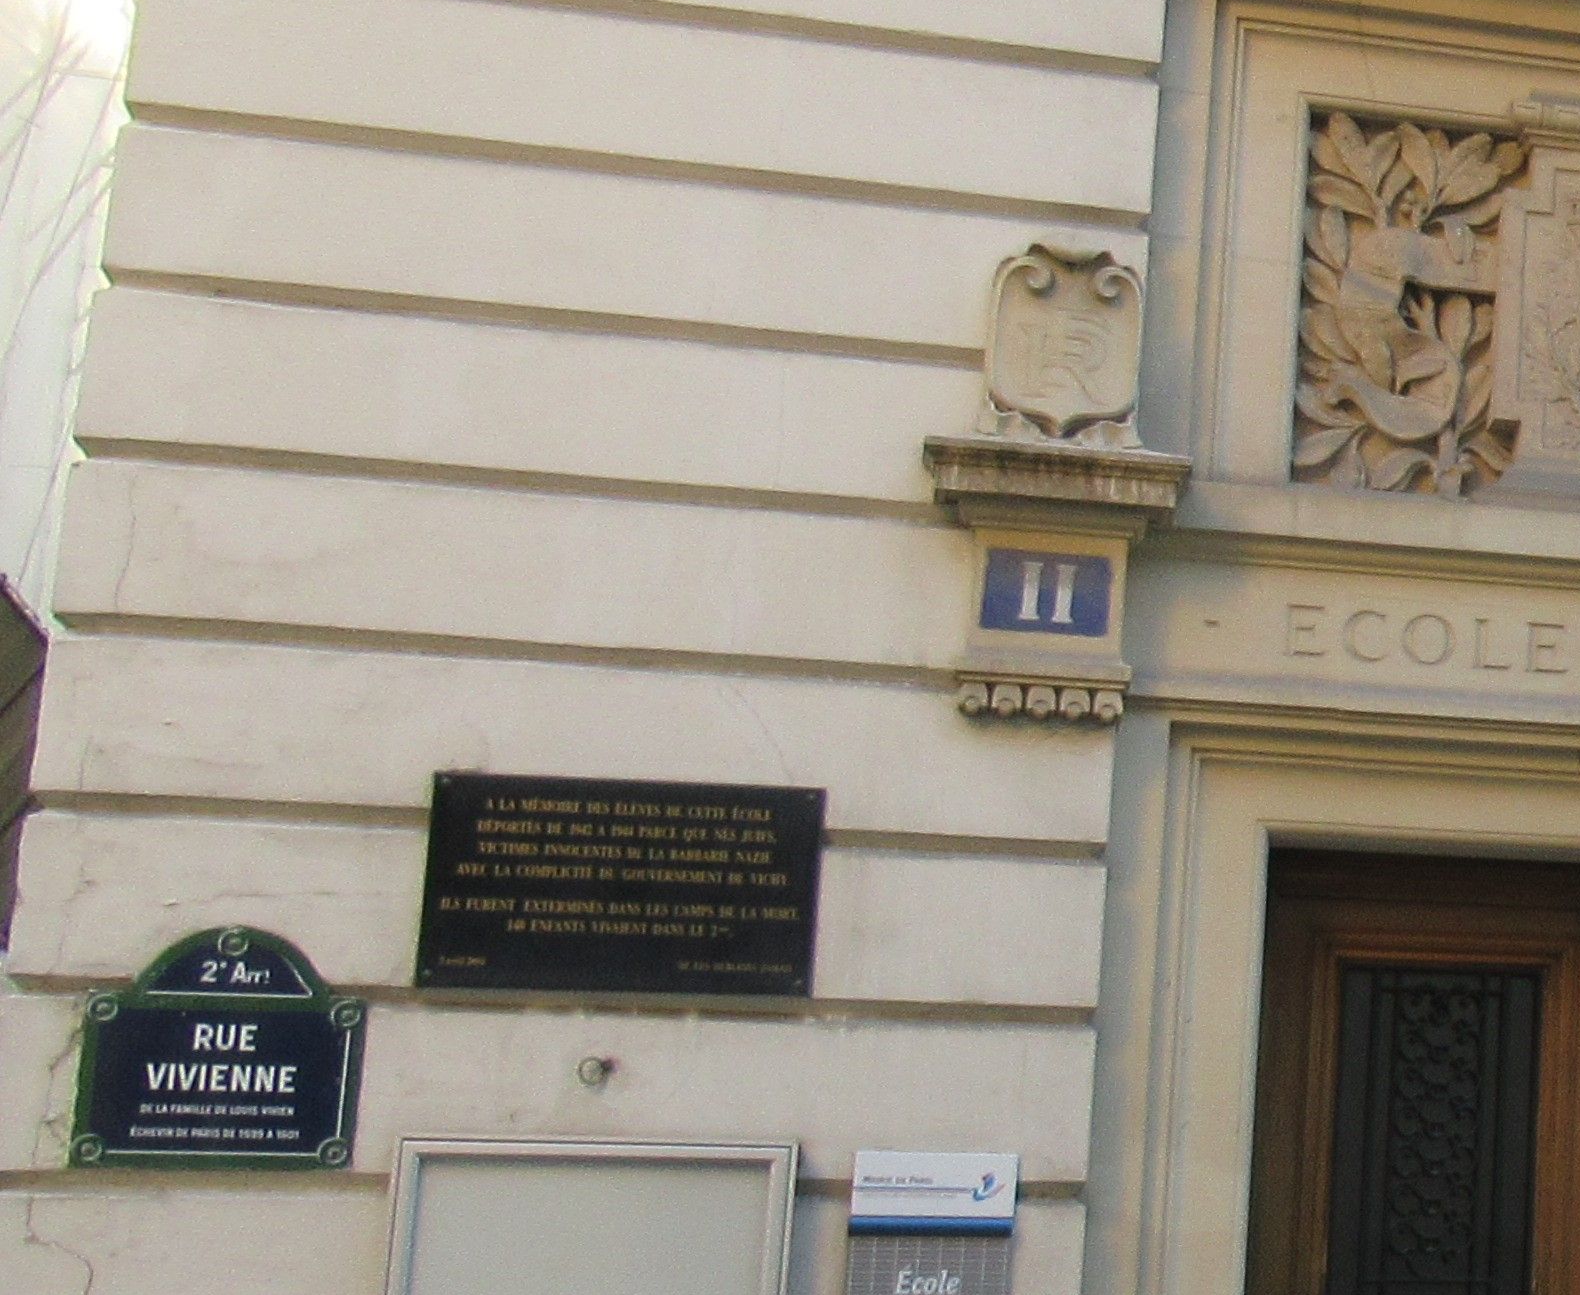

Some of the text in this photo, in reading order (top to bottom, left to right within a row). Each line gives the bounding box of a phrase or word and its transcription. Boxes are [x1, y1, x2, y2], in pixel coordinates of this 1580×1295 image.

[1284, 603, 1568, 673] ECOLE
[192, 1023, 258, 1052] RUE
[146, 1062, 298, 1093] VIVIENNE
[155, 1103, 168, 1114] LA
[895, 1265, 962, 1294] École
